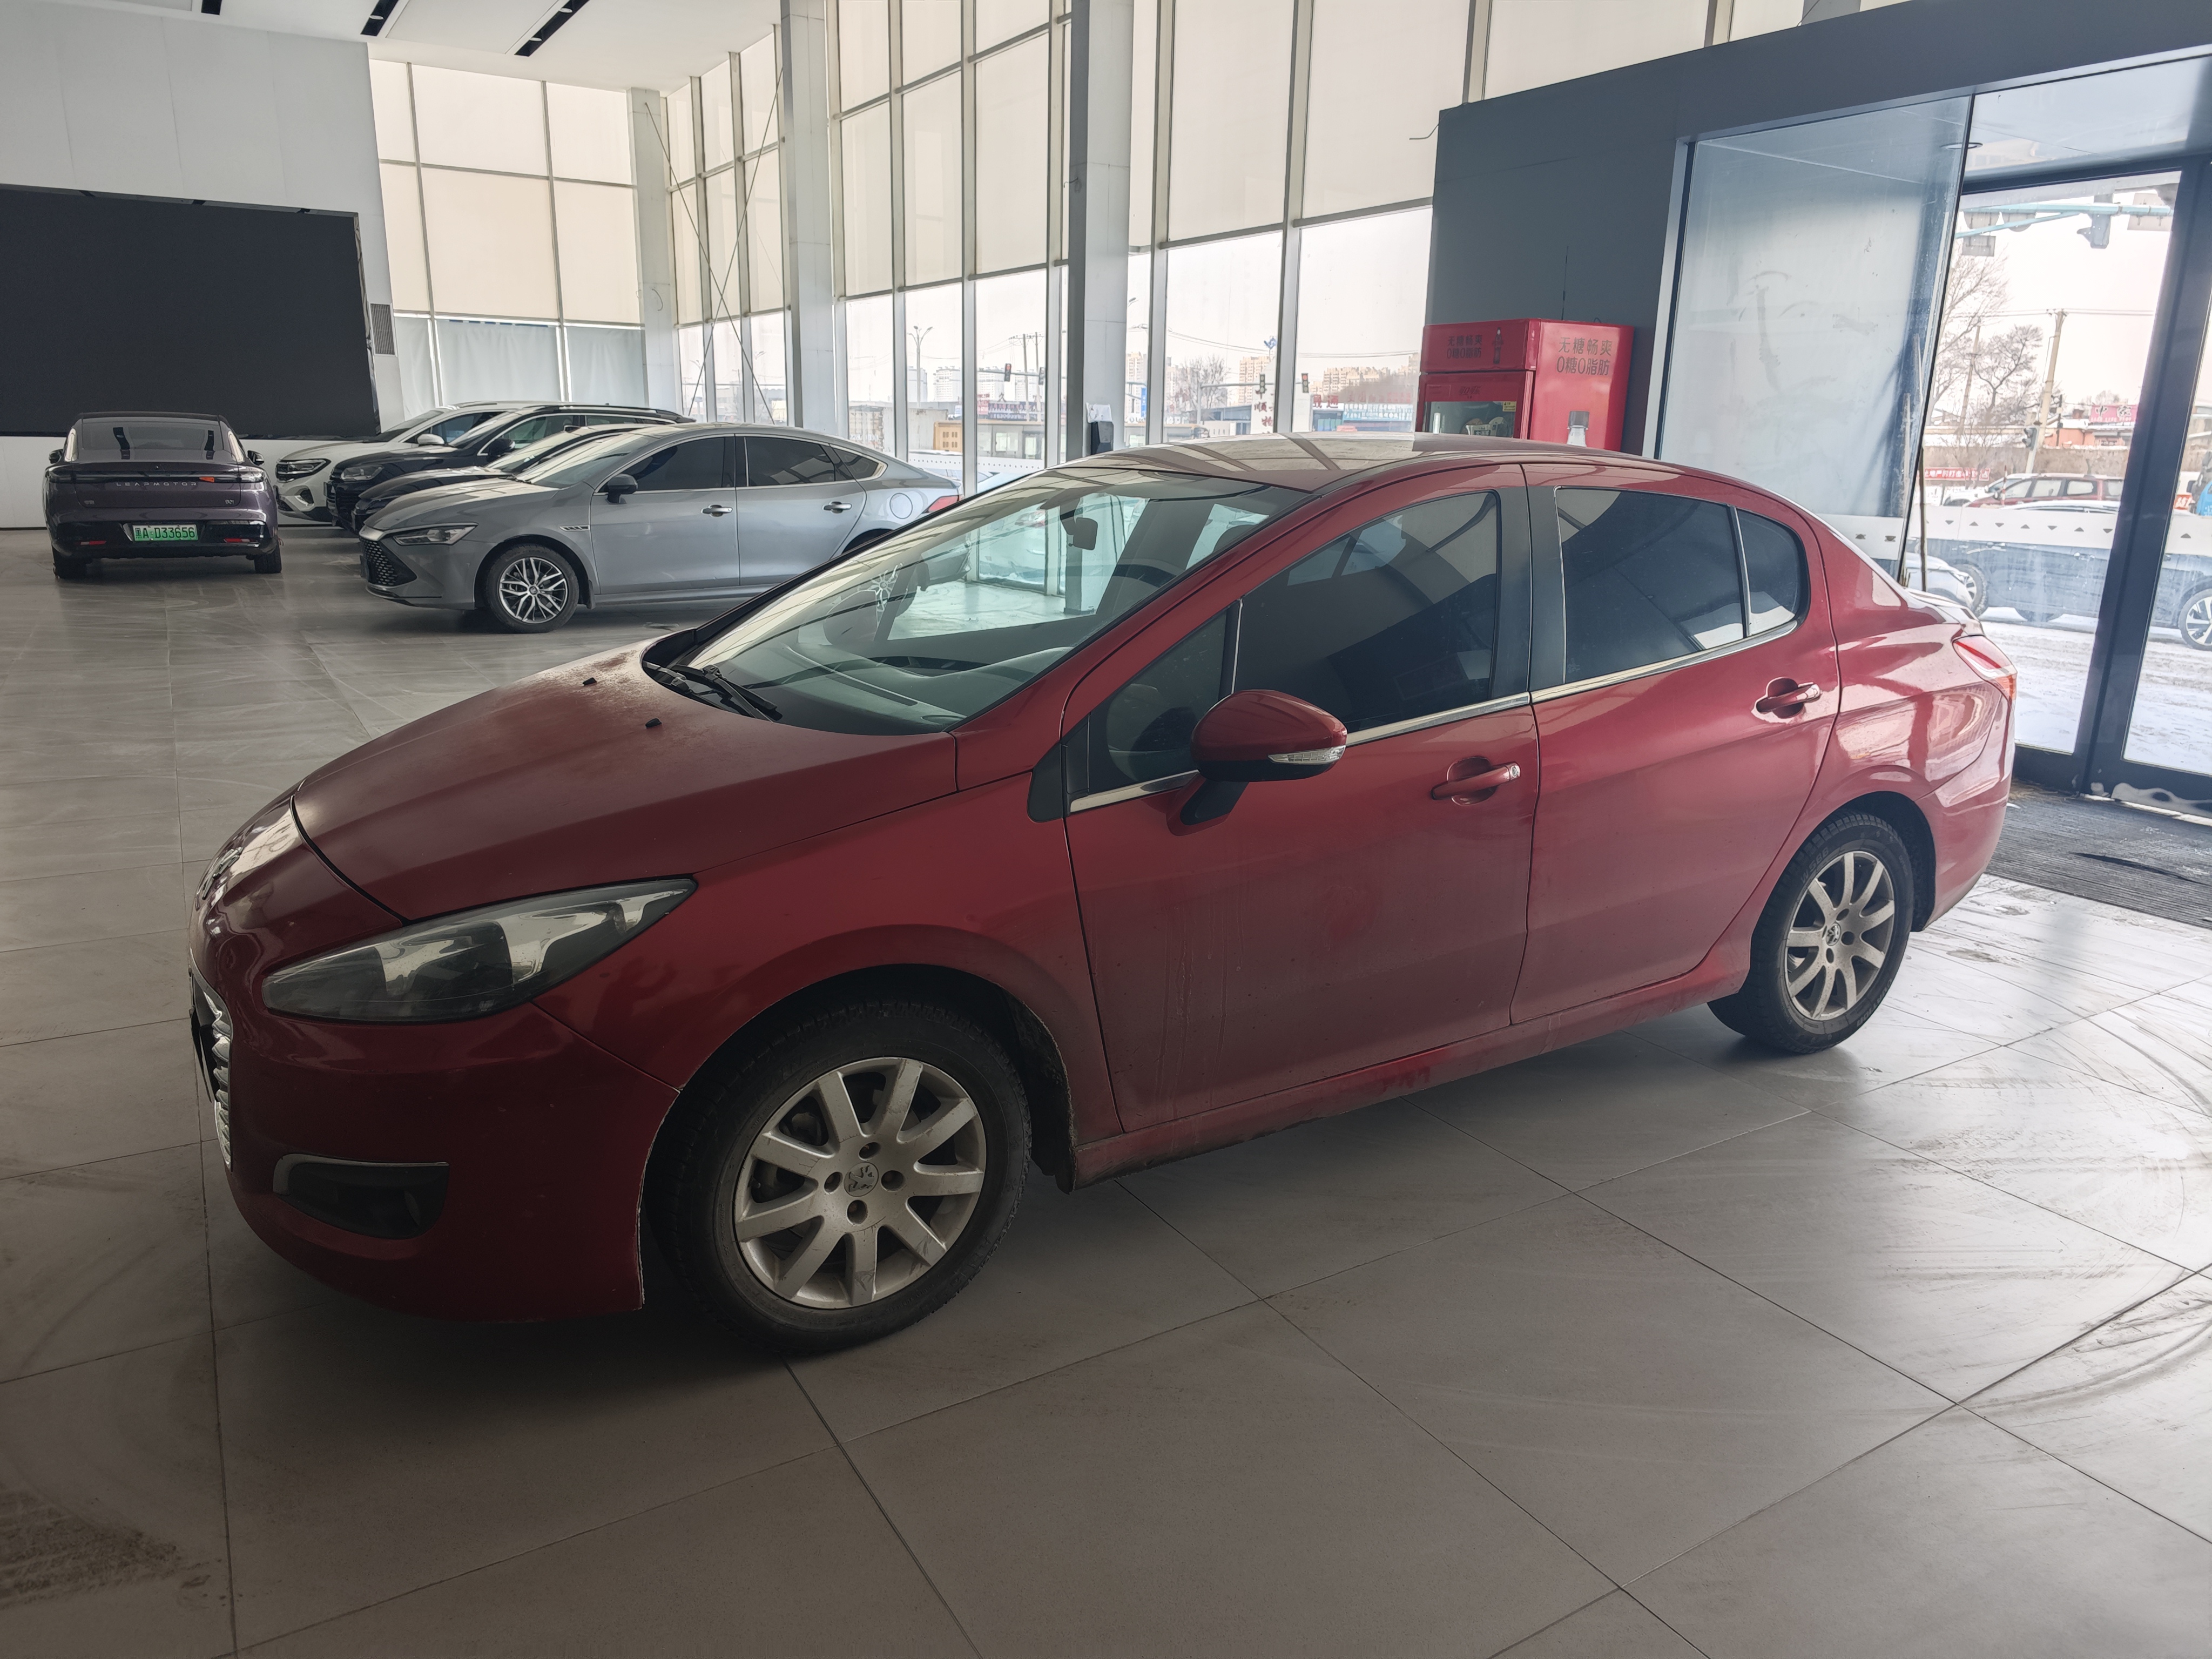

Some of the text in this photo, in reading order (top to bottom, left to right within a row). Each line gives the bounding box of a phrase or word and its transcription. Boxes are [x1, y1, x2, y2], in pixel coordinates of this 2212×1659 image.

[1447, 334, 1482, 346] 无糖畅爽
[1558, 337, 1613, 356] 无糖畅爽
[1556, 356, 1611, 376] 0糖0脂肪
